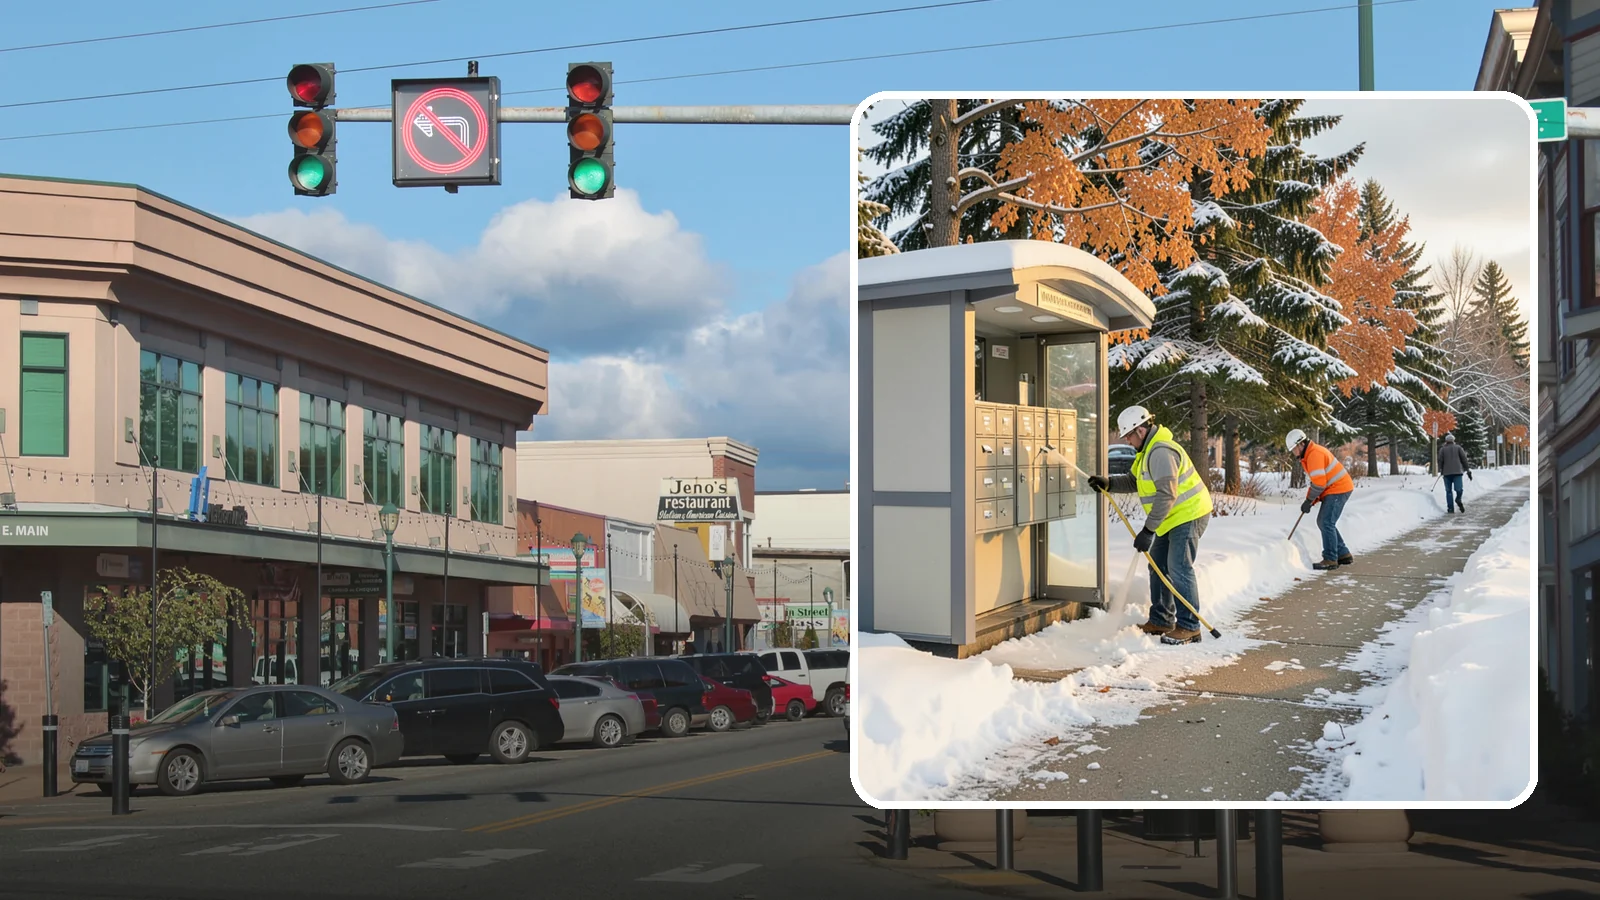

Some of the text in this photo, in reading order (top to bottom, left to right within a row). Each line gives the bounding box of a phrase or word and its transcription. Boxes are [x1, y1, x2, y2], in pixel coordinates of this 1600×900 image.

[670, 480, 727, 494] Jeno's
[665, 496, 731, 509] restaurant
[686, 509, 714, 519] American
[715, 509, 737, 519] Cuisine
[2, 525, 49, 536] E. MAIN
[797, 607, 828, 617] Street
